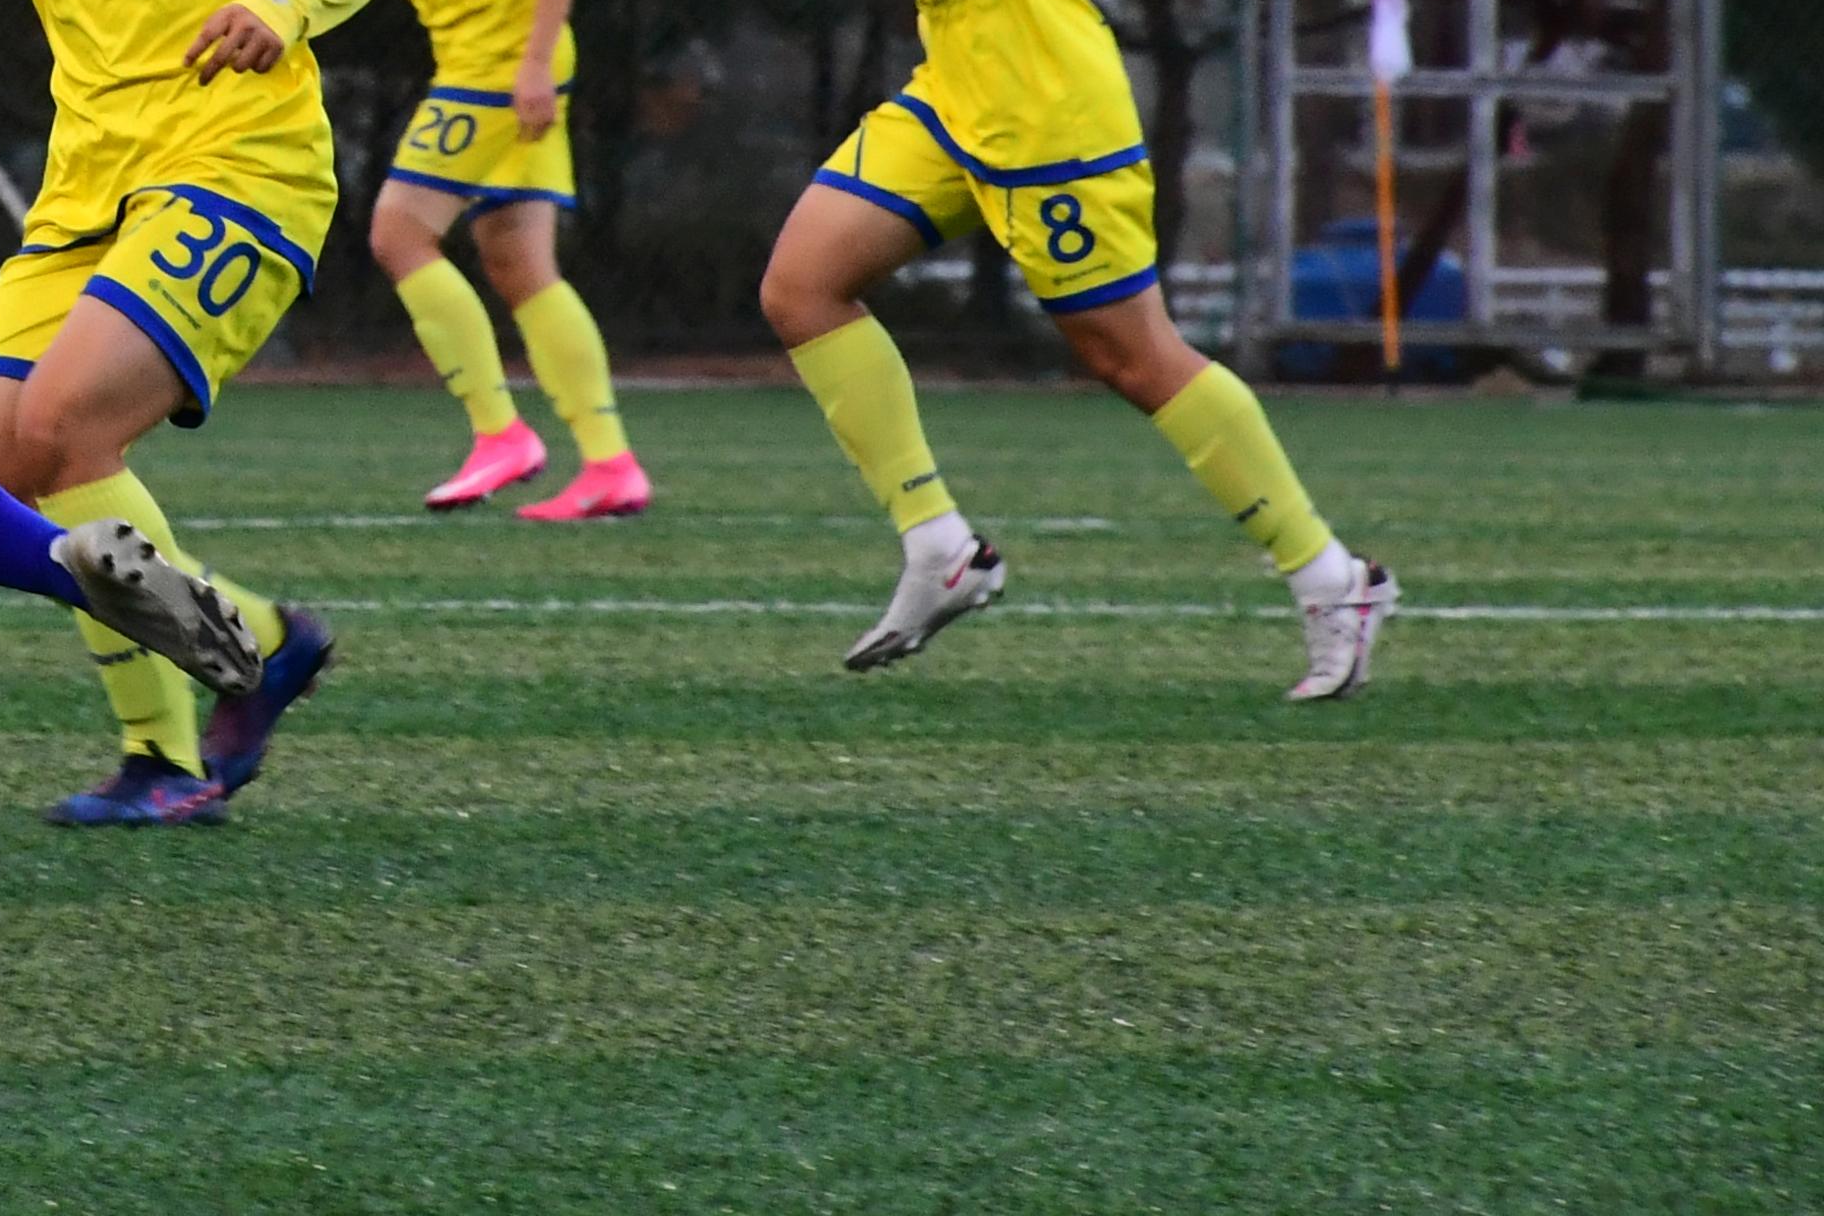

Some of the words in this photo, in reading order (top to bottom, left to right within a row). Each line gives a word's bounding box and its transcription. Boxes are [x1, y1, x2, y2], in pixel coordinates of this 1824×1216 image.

[409, 105, 477, 156] 20
[150, 200, 262, 318] 30
[1039, 193, 1097, 264] 8
